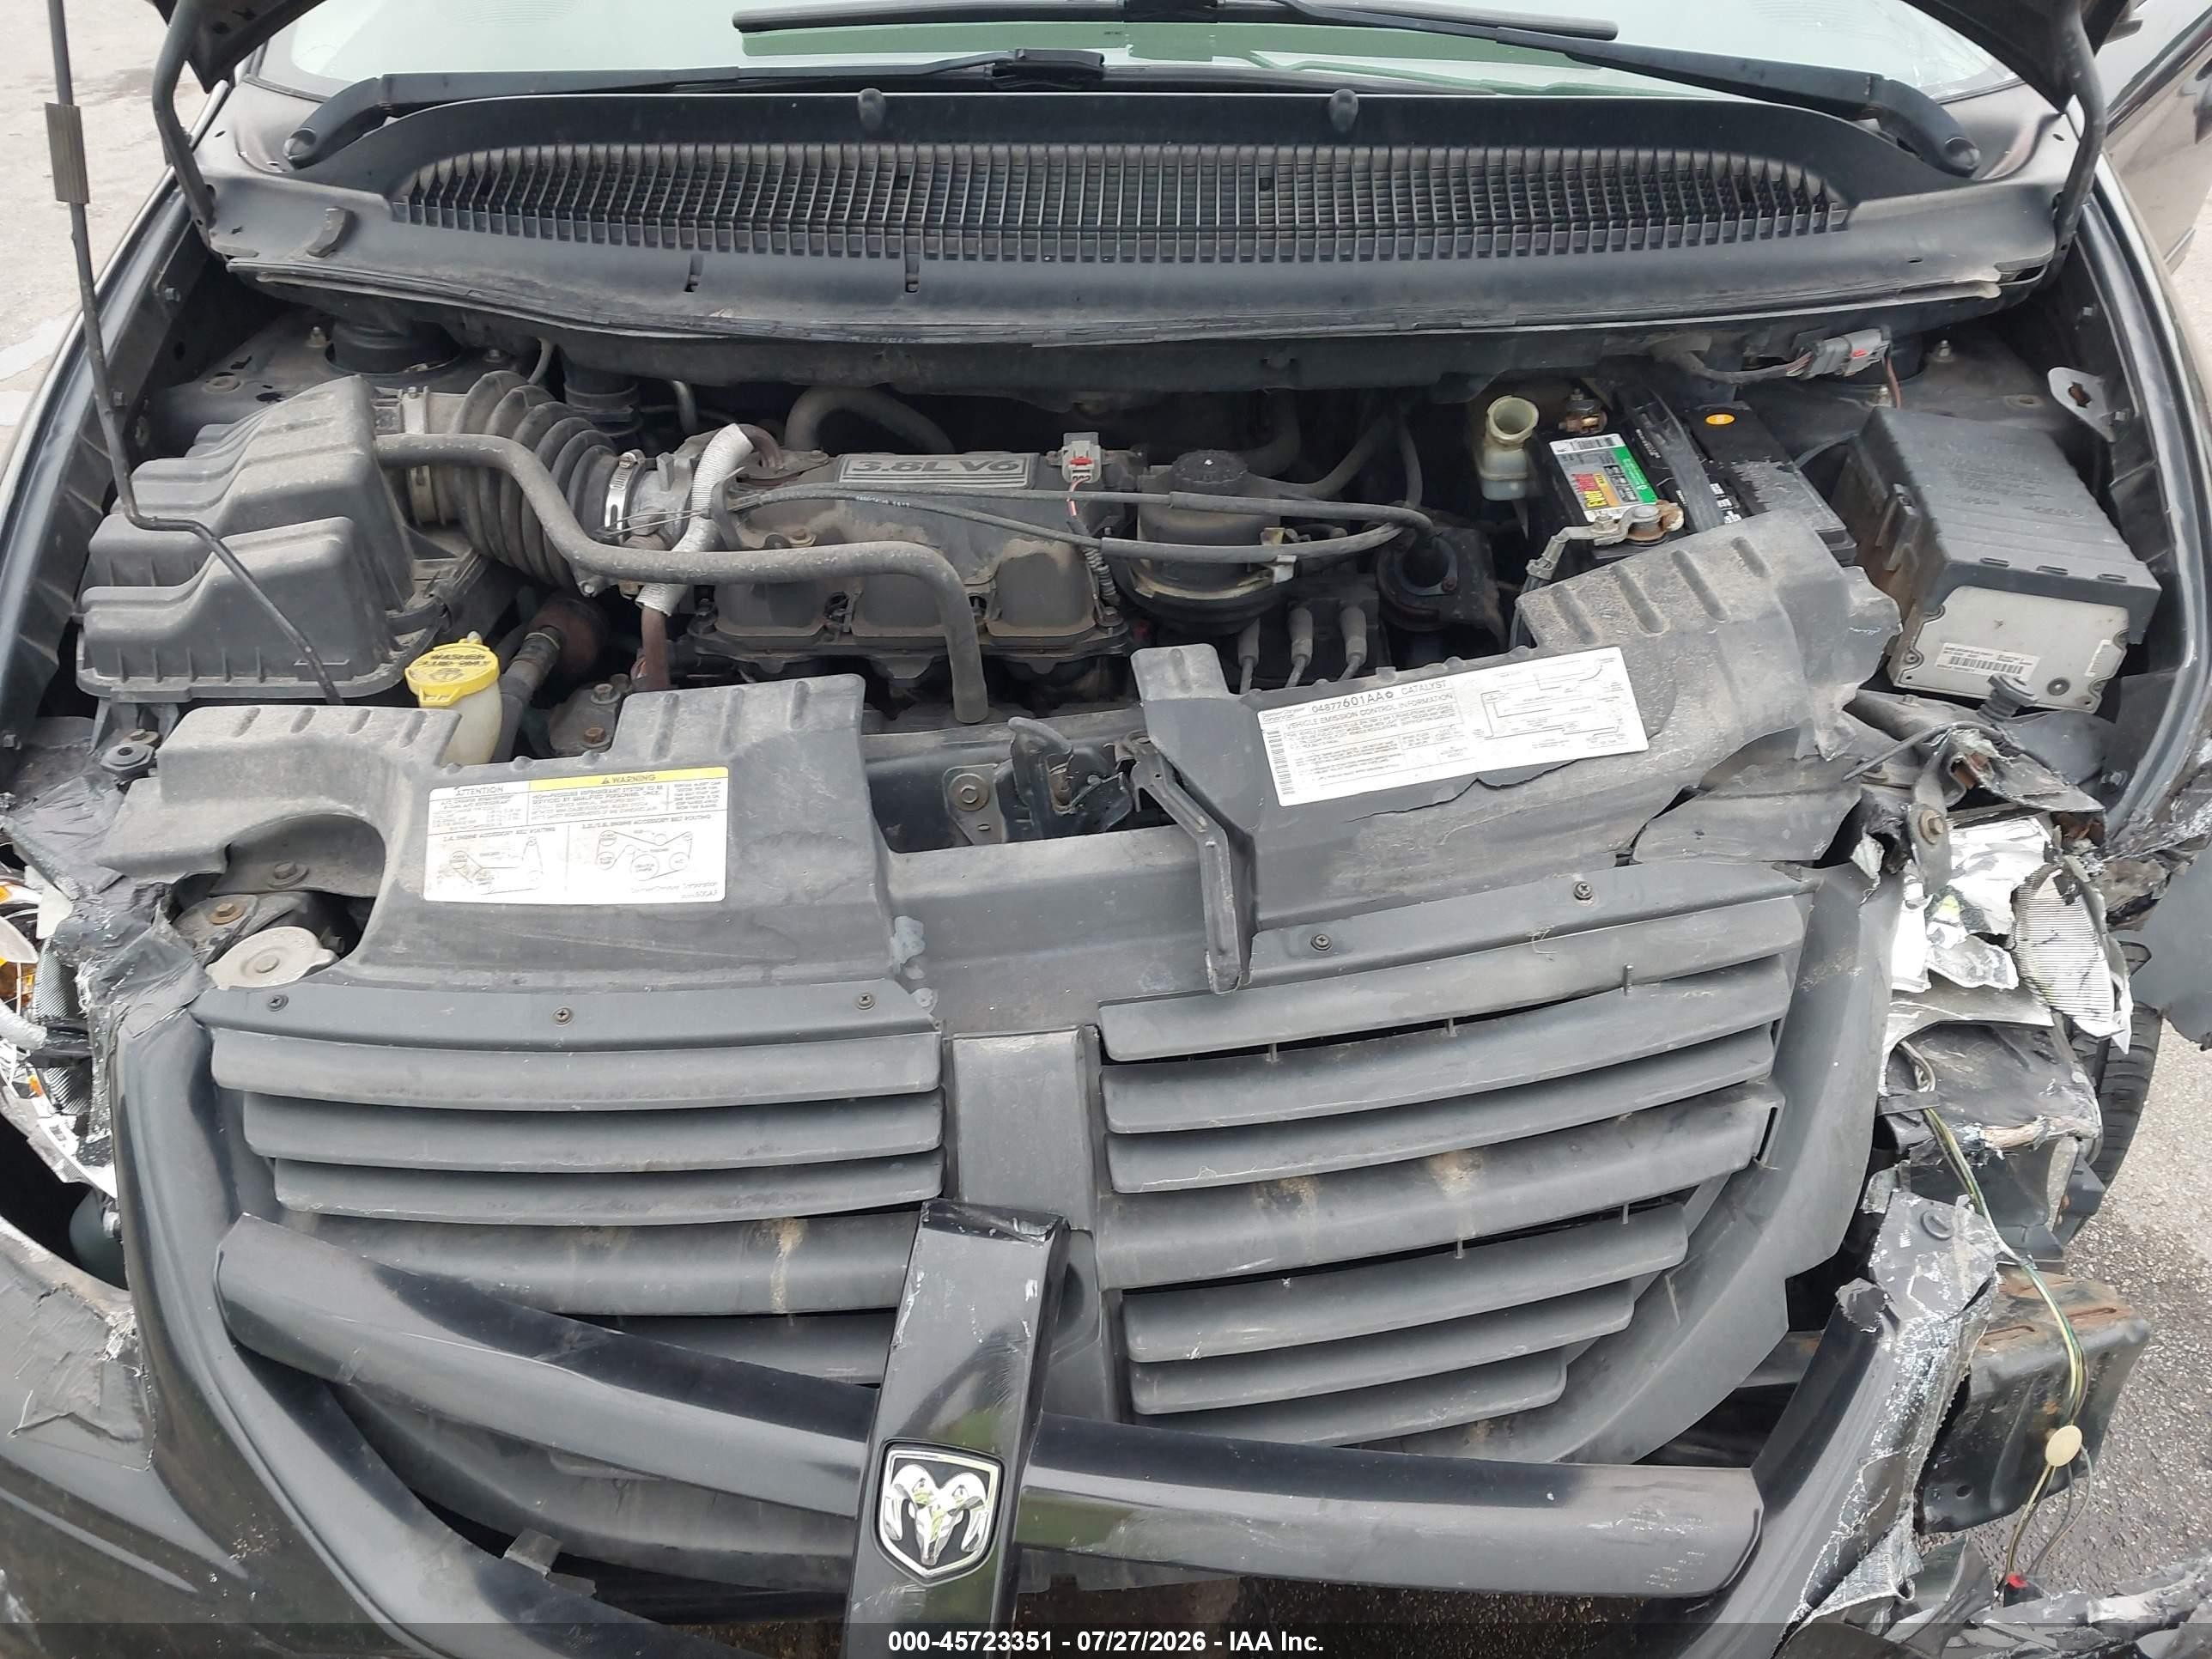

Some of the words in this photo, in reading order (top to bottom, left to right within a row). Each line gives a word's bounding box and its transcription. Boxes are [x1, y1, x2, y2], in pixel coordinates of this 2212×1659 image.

[853, 459, 953, 473] 3.8L
[961, 459, 1019, 471] V6
[1401, 679, 1447, 696] CATALYST
[1311, 691, 1384, 714] 04877601AA
[1287, 718, 1317, 730] VEHICLE
[1320, 711, 1358, 723] EMISSION
[1360, 704, 1397, 716] CONTROL
[1400, 693, 1453, 709] INFORMATION
[612, 774, 656, 784] WARNING
[455, 785, 504, 797] ATTENTION
